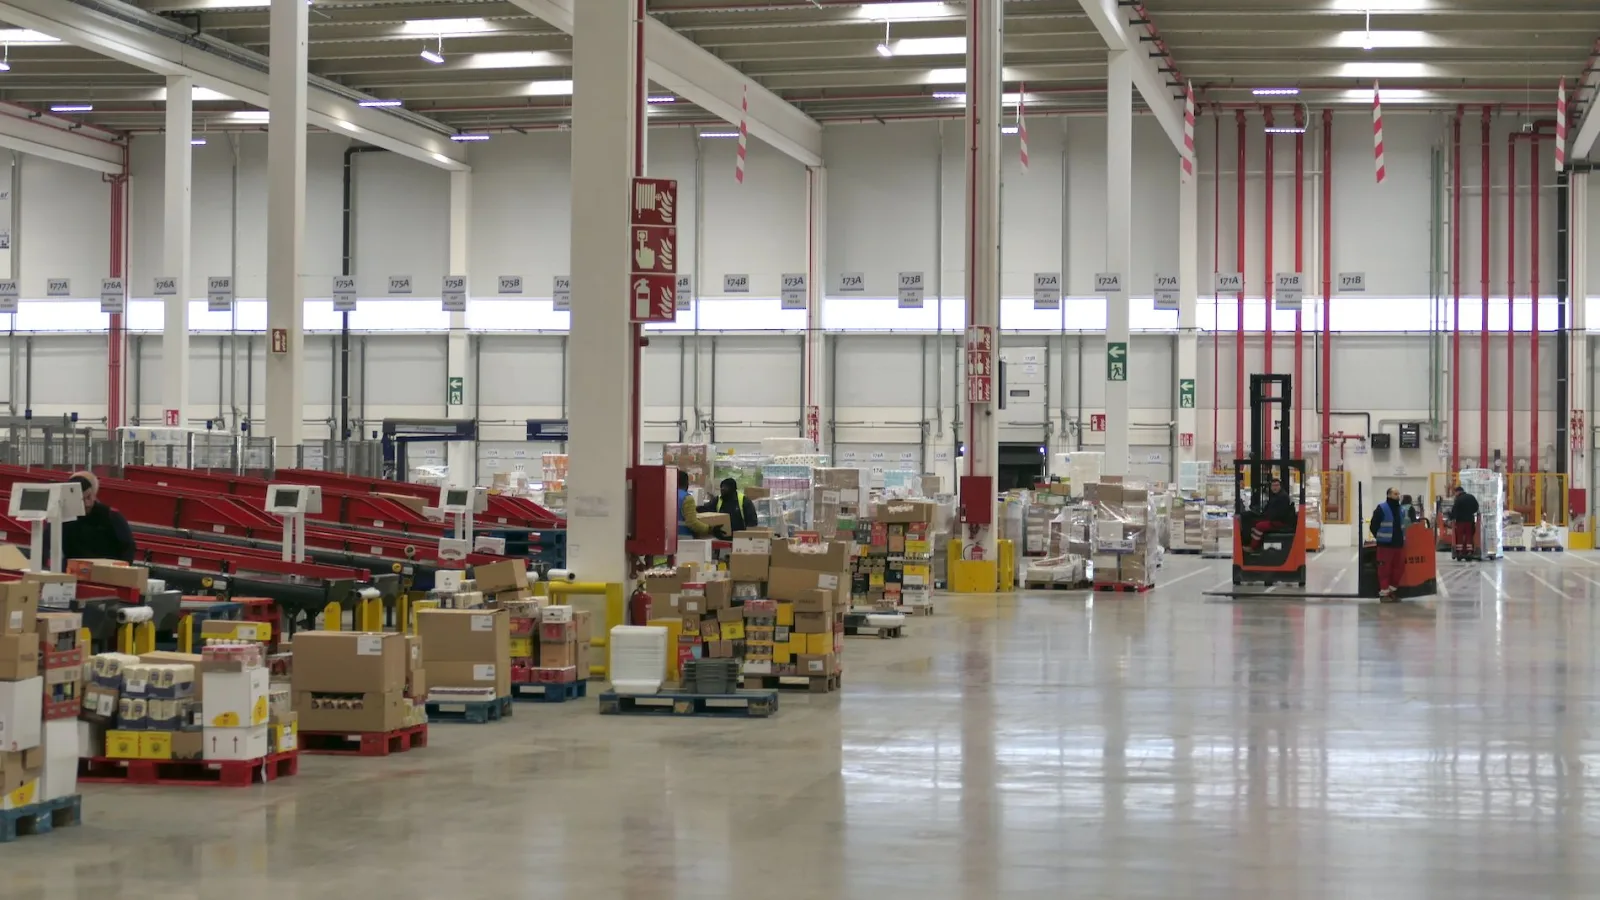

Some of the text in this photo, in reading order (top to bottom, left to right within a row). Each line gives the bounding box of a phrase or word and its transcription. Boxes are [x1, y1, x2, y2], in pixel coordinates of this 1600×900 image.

[156, 280, 174, 289] 176A
[211, 280, 229, 289] 176B
[336, 279, 354, 289] 175A
[391, 279, 409, 288] 175A
[445, 279, 463, 289] 175B
[501, 279, 520, 288] 175B
[727, 277, 746, 287] 174B
[785, 276, 804, 286] 173A
[842, 276, 862, 286] 173A
[902, 275, 921, 285] 173B
[1037, 276, 1057, 286] 172A
[1098, 276, 1118, 286] 172A
[1157, 276, 1177, 286] 171A
[1219, 276, 1239, 286] 171A
[1279, 276, 1299, 286] 171B
[1342, 276, 1361, 286] 171B
[50, 282, 67, 290] 177A
[103, 281, 122, 290] 176A
